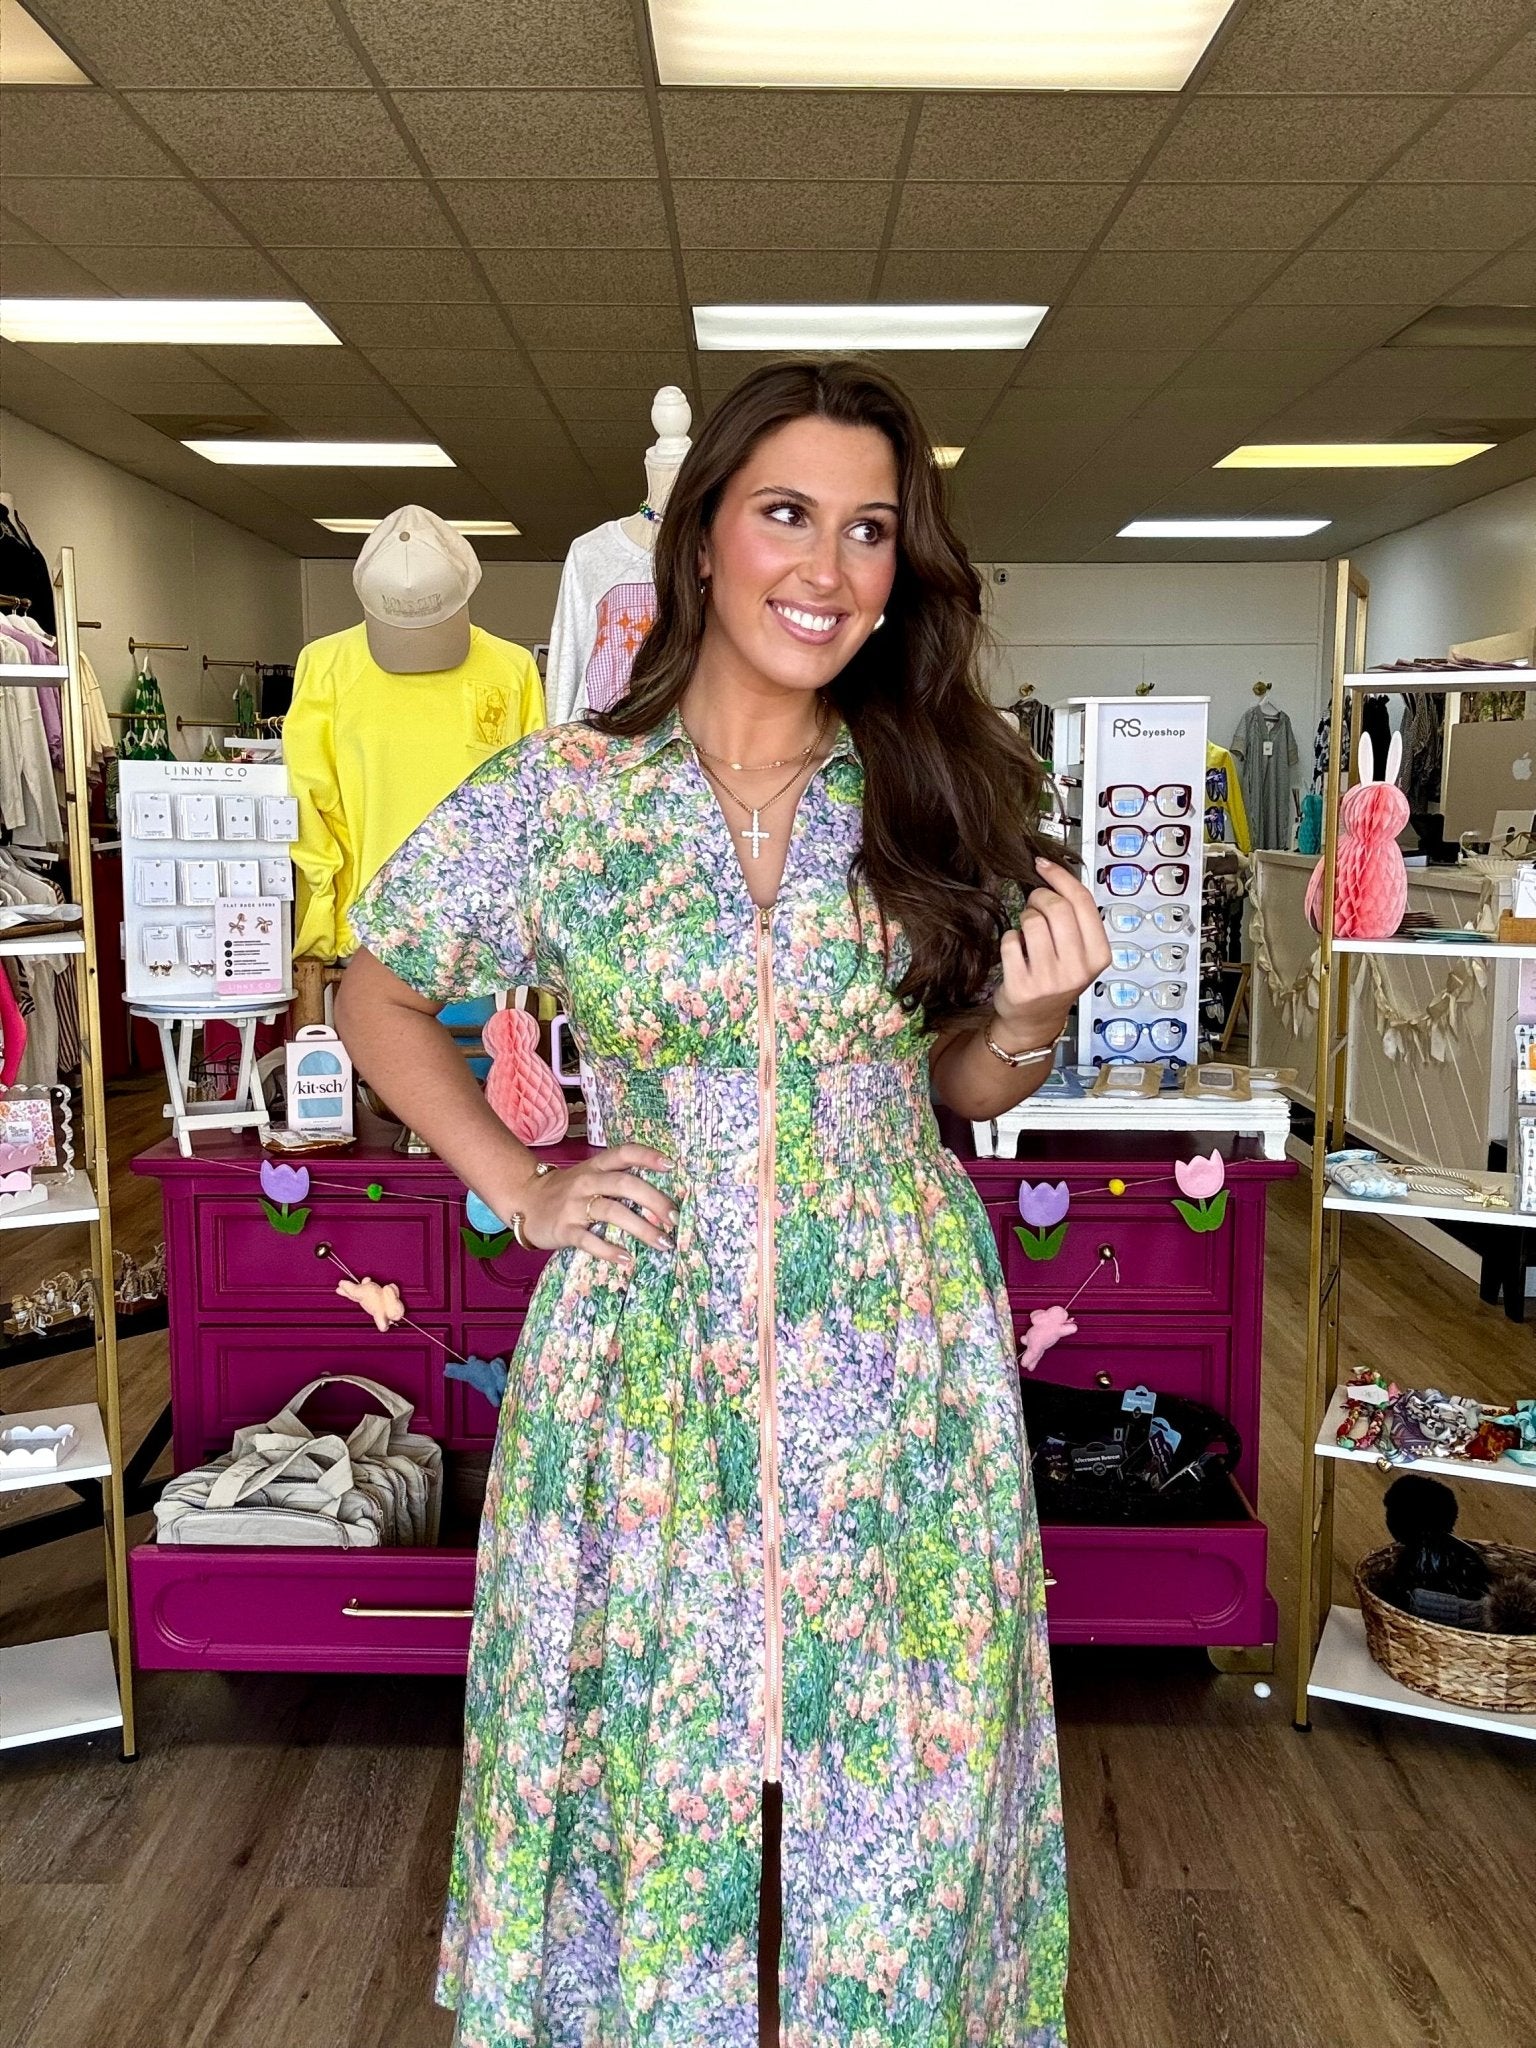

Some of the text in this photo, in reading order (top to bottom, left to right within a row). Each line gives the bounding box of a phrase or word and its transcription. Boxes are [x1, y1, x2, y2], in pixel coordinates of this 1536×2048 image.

[1113, 718, 1186, 738] RS eyeshop
[164, 766, 247, 777] LINNY CO
